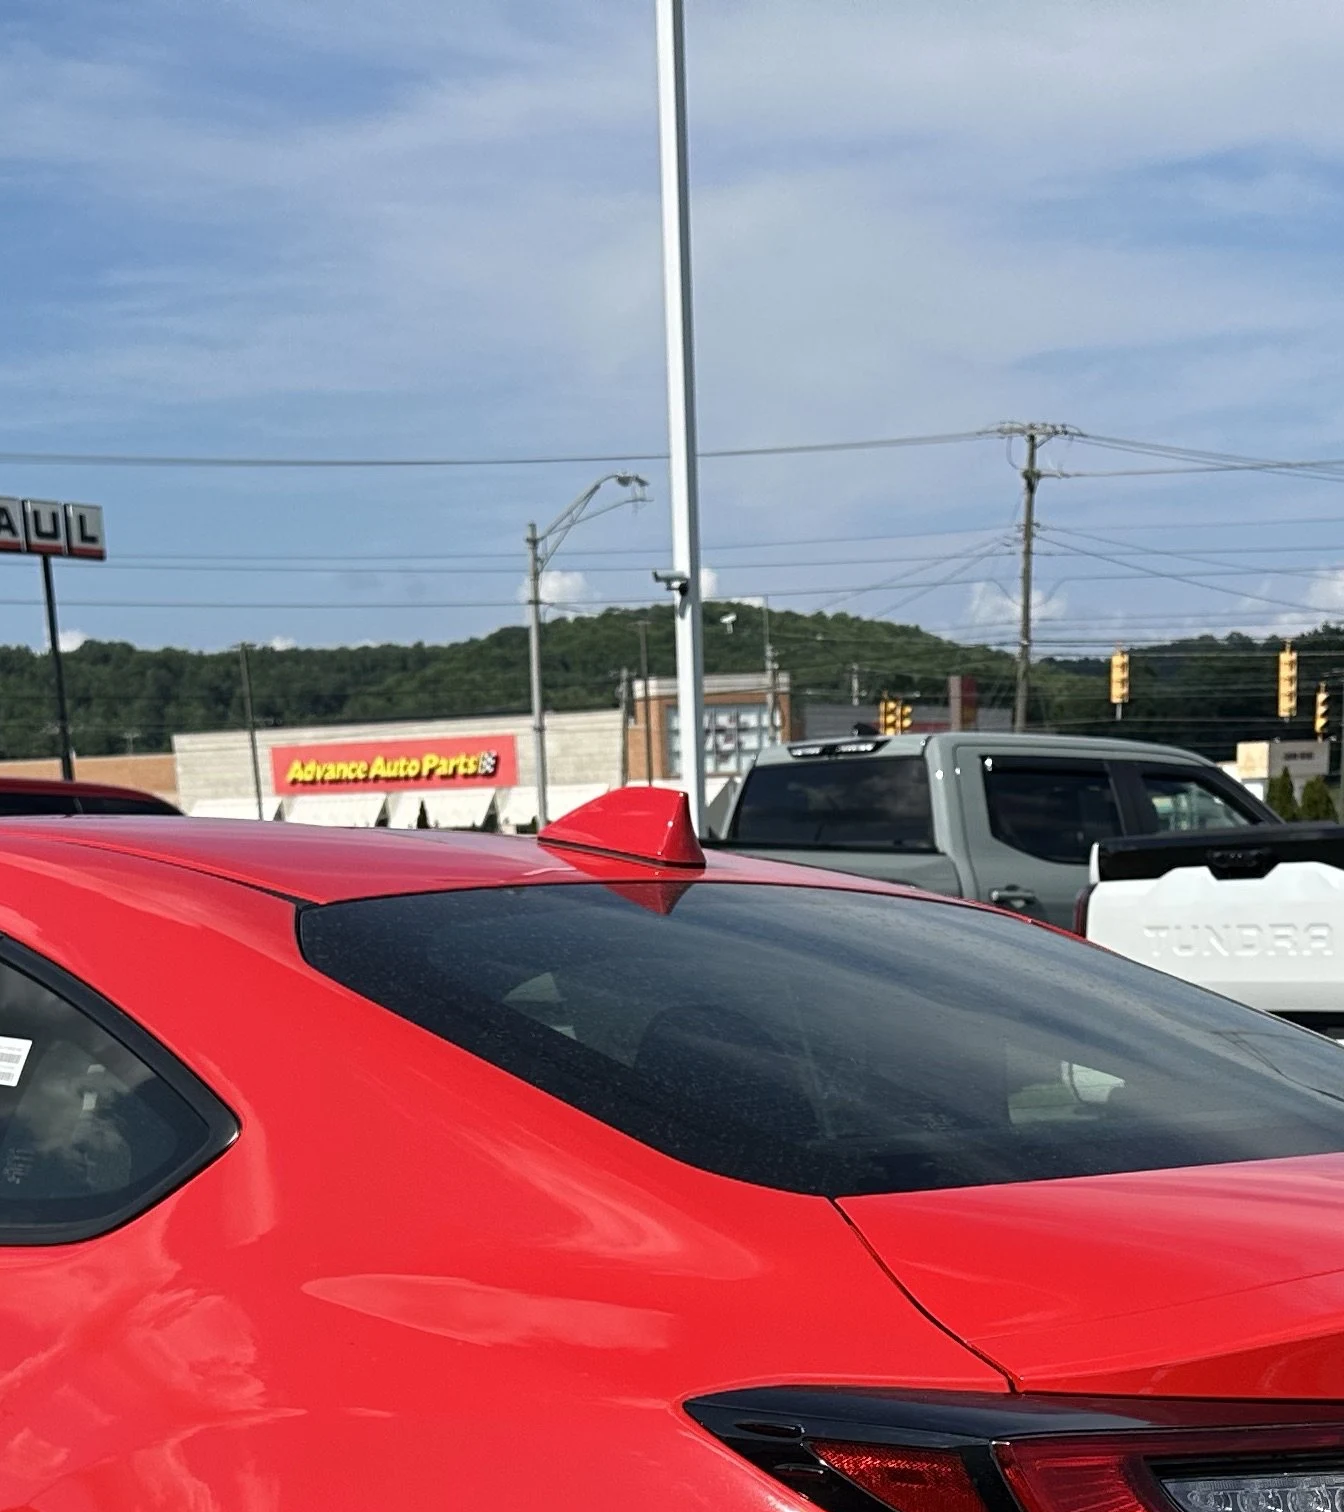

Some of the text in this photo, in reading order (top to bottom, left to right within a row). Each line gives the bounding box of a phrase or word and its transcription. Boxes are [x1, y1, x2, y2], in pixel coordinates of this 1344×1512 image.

[287, 752, 478, 783] Advance Auto Parts
[1143, 922, 1334, 957] TUNDRA
